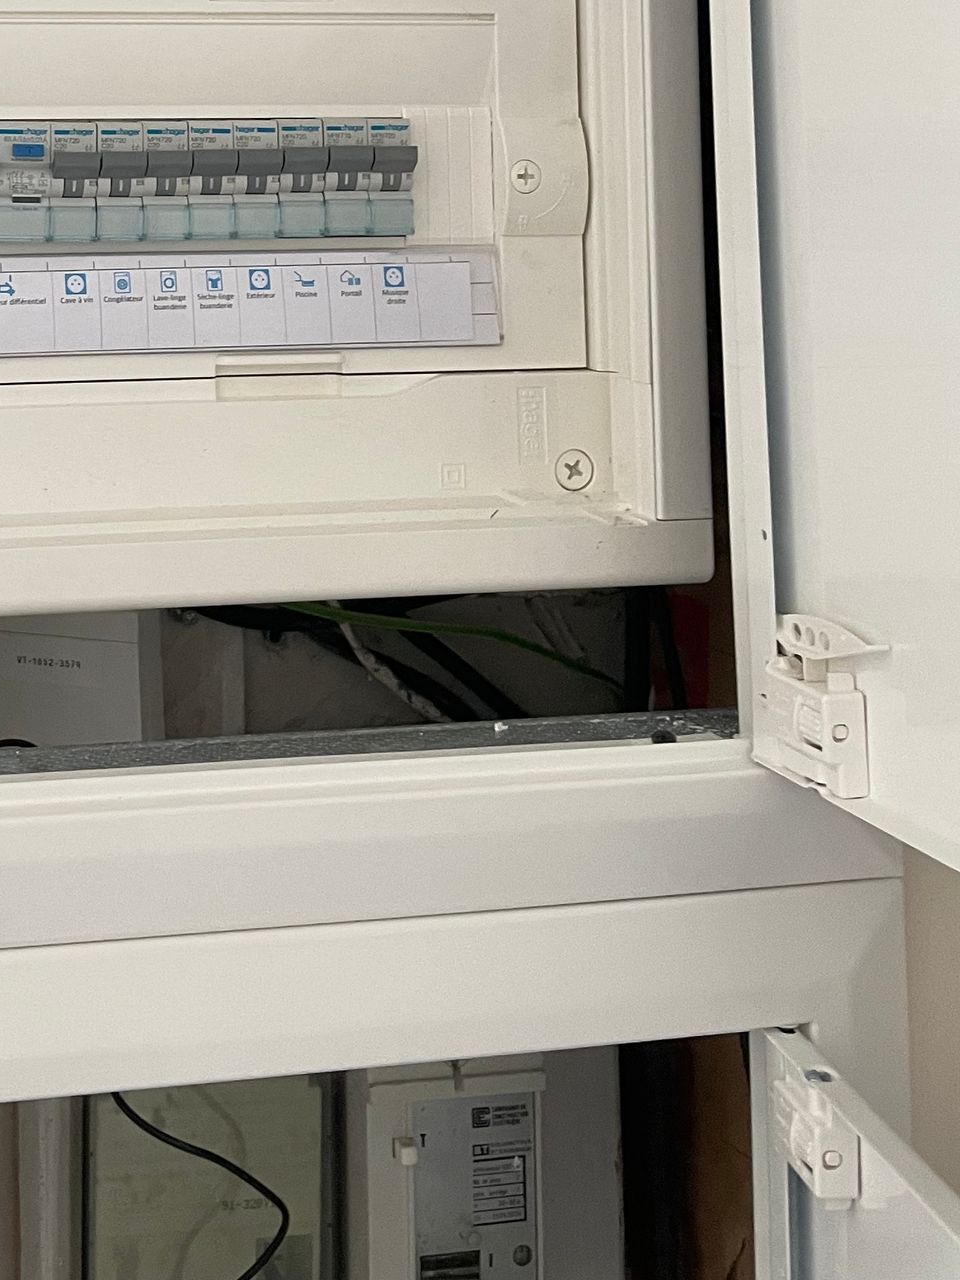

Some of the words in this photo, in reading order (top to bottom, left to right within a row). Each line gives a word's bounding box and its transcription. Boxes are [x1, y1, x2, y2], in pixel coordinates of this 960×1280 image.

[153, 294, 186, 302] Lave-linge
[246, 291, 276, 300] Extérieur
[341, 290, 362, 298] Portail
[9, 297, 47, 306] différentiel
[103, 295, 144, 303] Congélateur
